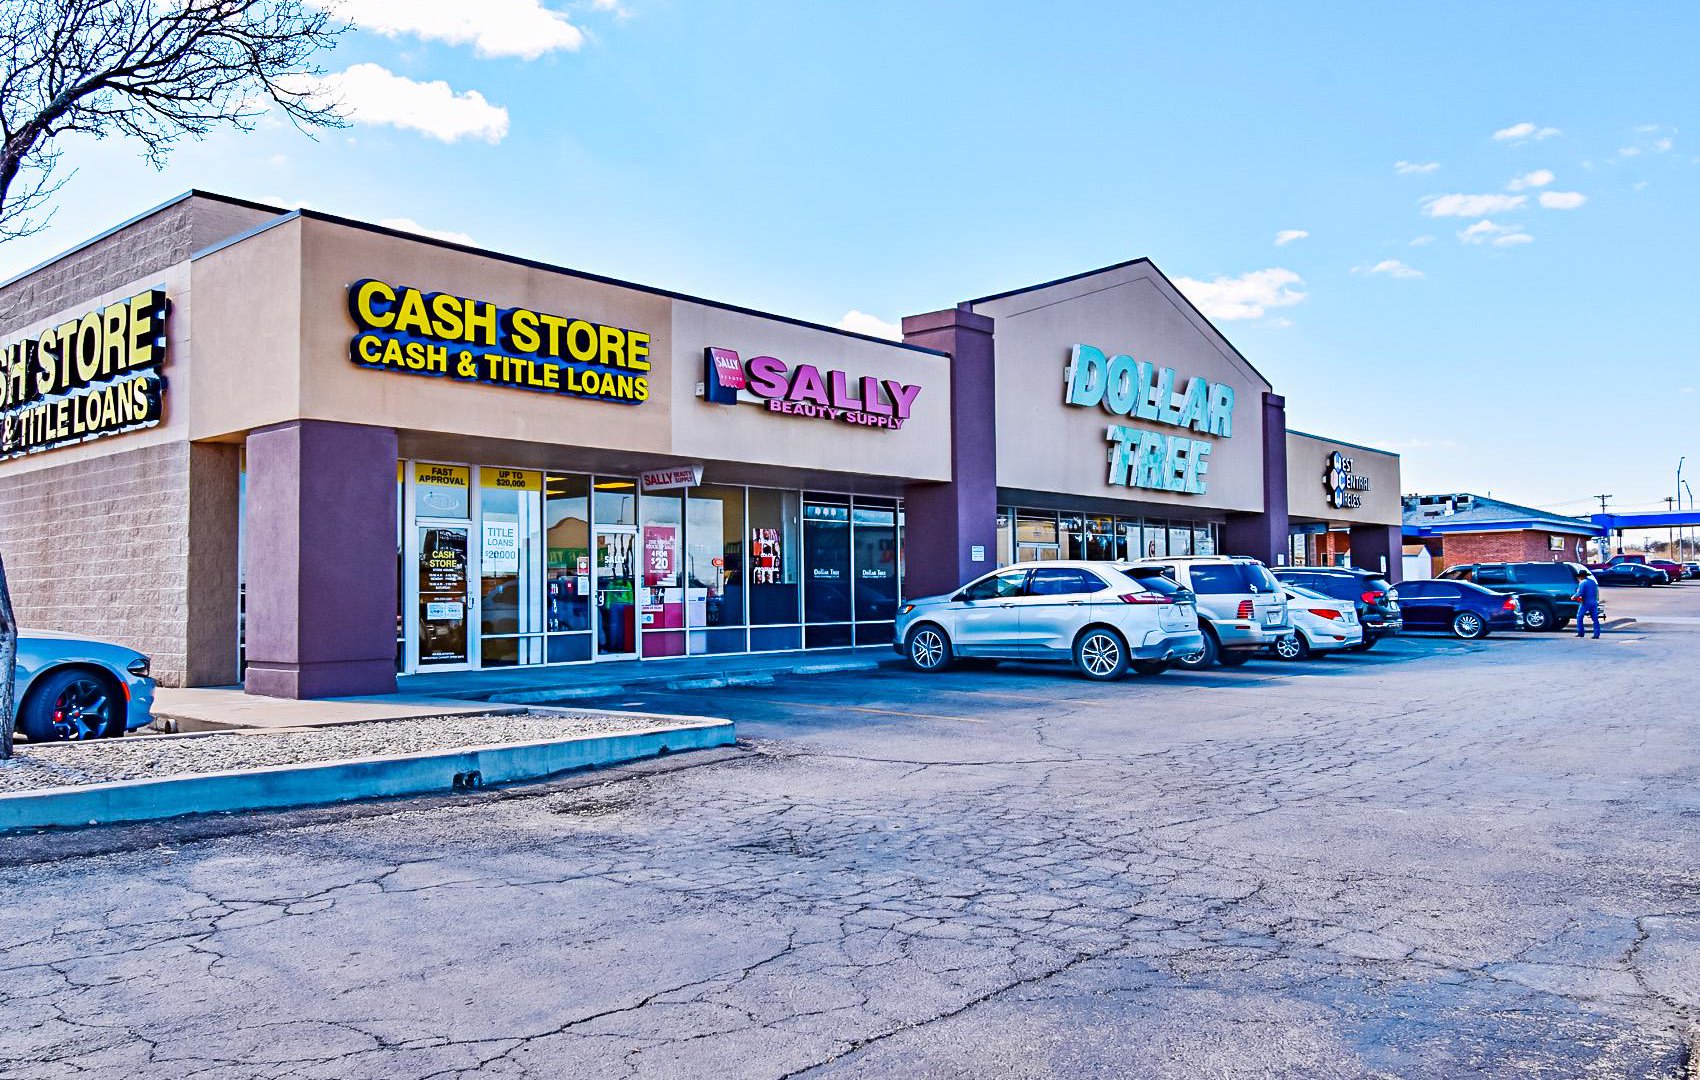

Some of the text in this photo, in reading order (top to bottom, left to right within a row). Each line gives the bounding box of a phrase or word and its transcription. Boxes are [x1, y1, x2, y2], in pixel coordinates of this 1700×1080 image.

[358, 281, 651, 372] CASH STORE
[36, 289, 153, 395] STORE
[358, 335, 649, 401] CASH & TITLE LOANS
[716, 357, 738, 370] SALLY
[750, 356, 922, 419] SALLY
[1066, 344, 1234, 438] DOLLAR
[20, 398, 69, 447] TITLE
[74, 377, 148, 434] LOANS
[770, 400, 905, 430] BEAUTY SUPPLY
[1107, 425, 1212, 495] TREE
[431, 467, 454, 476] FAST
[499, 471, 523, 480] UP TO
[419, 475, 466, 486] APPROVAL
[496, 478, 526, 488] $20,000
[644, 472, 673, 486] SALLY
[487, 527, 514, 538] TITLE
[487, 538, 514, 547] LOANS
[432, 551, 455, 559] CASH
[605, 556, 626, 564] SALLY
[429, 560, 457, 568] STORE
[651, 557, 669, 570] $20
